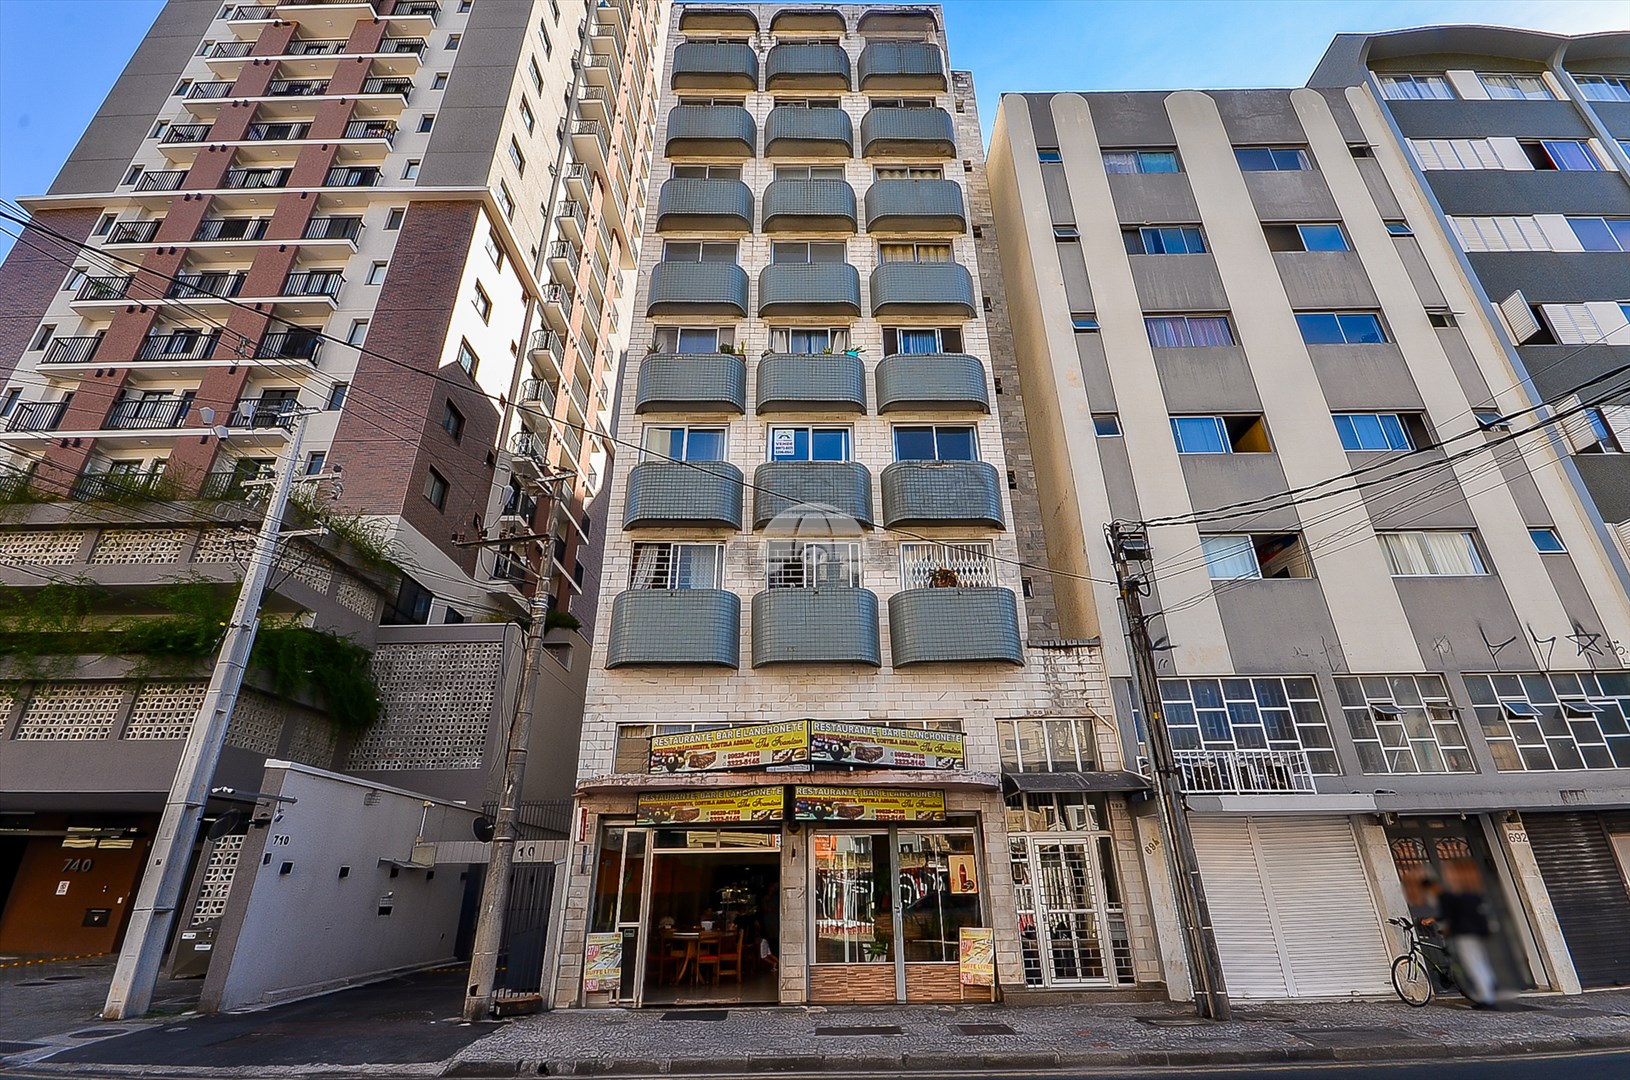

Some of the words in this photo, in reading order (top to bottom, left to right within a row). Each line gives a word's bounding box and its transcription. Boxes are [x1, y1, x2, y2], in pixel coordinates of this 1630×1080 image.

[653, 734, 714, 747] RESTAURANTE,
[716, 730, 735, 740] BAR
[736, 729, 740, 738] E
[743, 722, 803, 737] LANCHONETE
[814, 722, 880, 736] RESTAURANTE,
[882, 727, 898, 737] BAR
[901, 729, 906, 738] E
[908, 729, 961, 743] LANCHONETE
[755, 737, 769, 748] The
[771, 735, 803, 747] Fountain
[920, 741, 932, 752] The
[934, 743, 962, 755] Fountain
[700, 791, 717, 799] BAR
[725, 787, 783, 798] LANCHONETE
[889, 790, 942, 798] LANCHONETE
[736, 798, 751, 808] The
[752, 797, 782, 807] Fountain
[901, 799, 914, 808] The
[915, 800, 943, 808] Fountain
[273, 835, 290, 846] 710
[1508, 832, 1528, 843] 692
[518, 846, 535, 857] 10
[61, 858, 93, 873] 740
